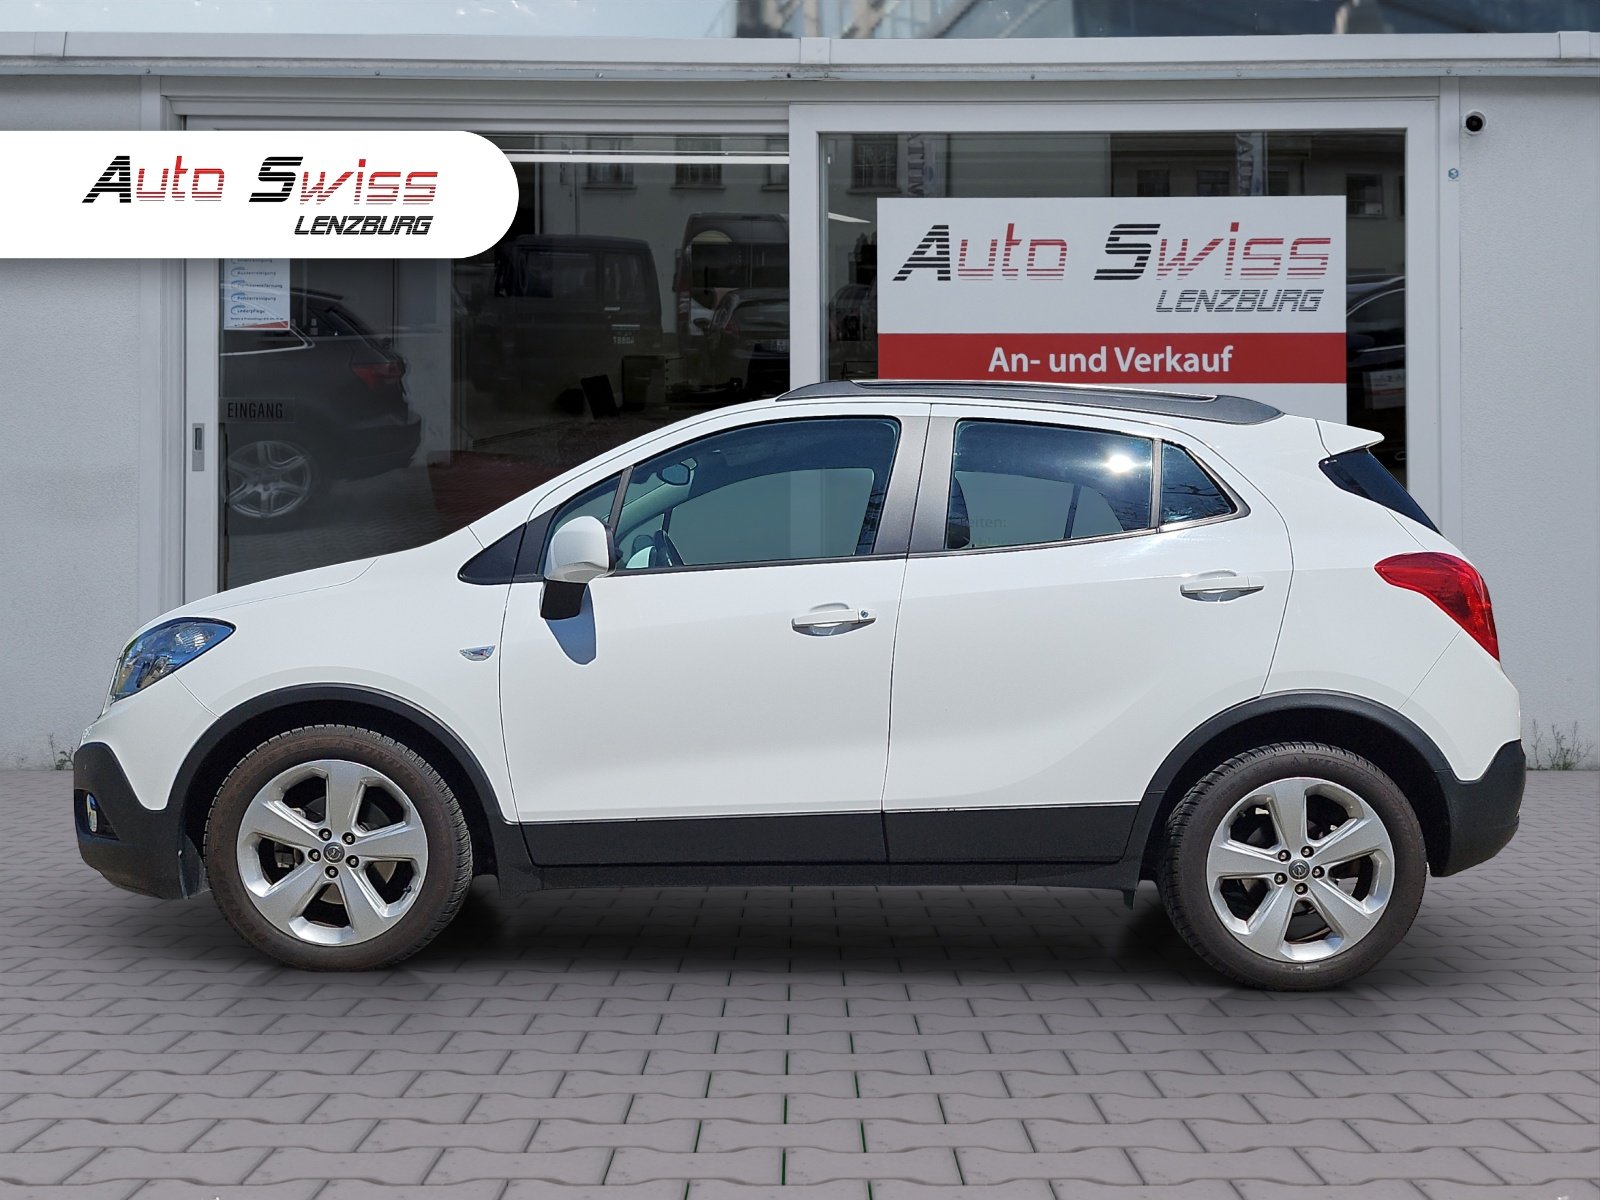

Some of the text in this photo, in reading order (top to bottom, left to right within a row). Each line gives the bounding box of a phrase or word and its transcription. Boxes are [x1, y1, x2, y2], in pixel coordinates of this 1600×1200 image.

[893, 222, 1332, 281] Auto Swiss
[1156, 289, 1325, 313] LENZBURG
[988, 345, 1234, 373] An- und Verkauf
[227, 402, 283, 418] EINGANG
